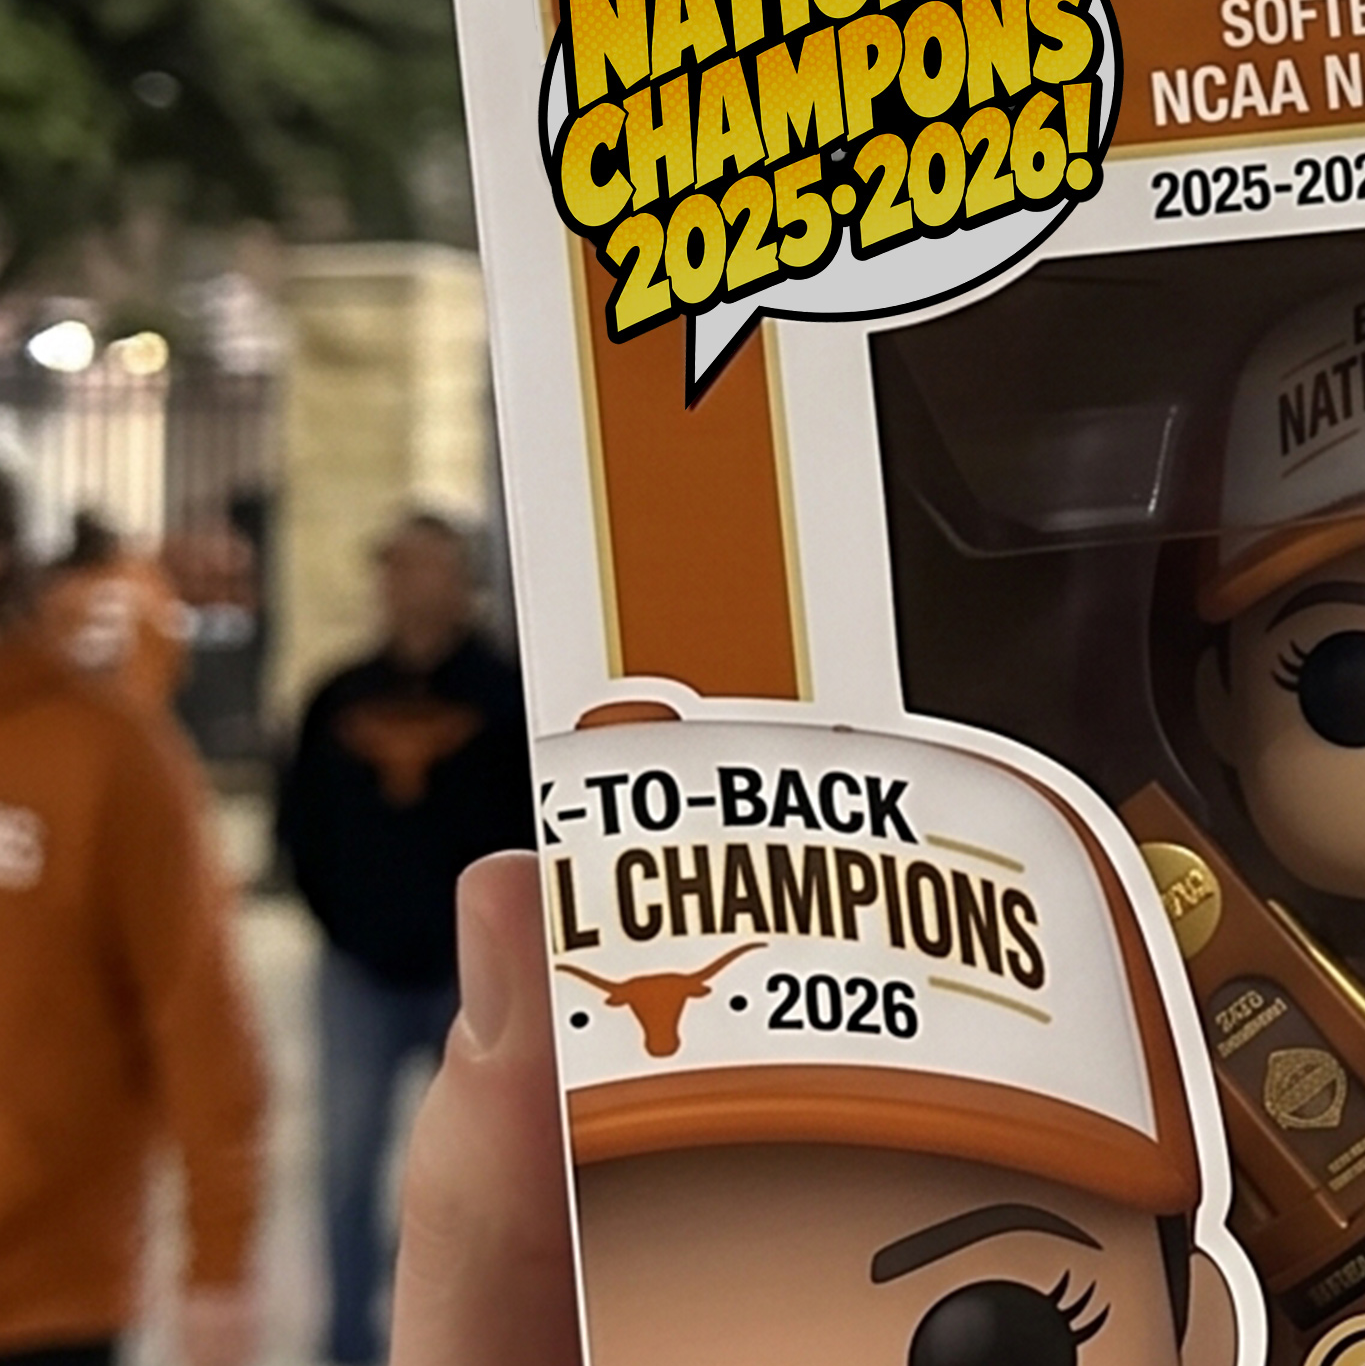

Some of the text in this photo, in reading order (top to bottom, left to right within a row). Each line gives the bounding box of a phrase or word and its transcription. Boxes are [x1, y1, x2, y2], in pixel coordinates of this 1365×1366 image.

[1149, 59, 1310, 126] NCAA
[616, 843, 1045, 990] CHAMPIONS
[766, 973, 918, 1039] 2026
